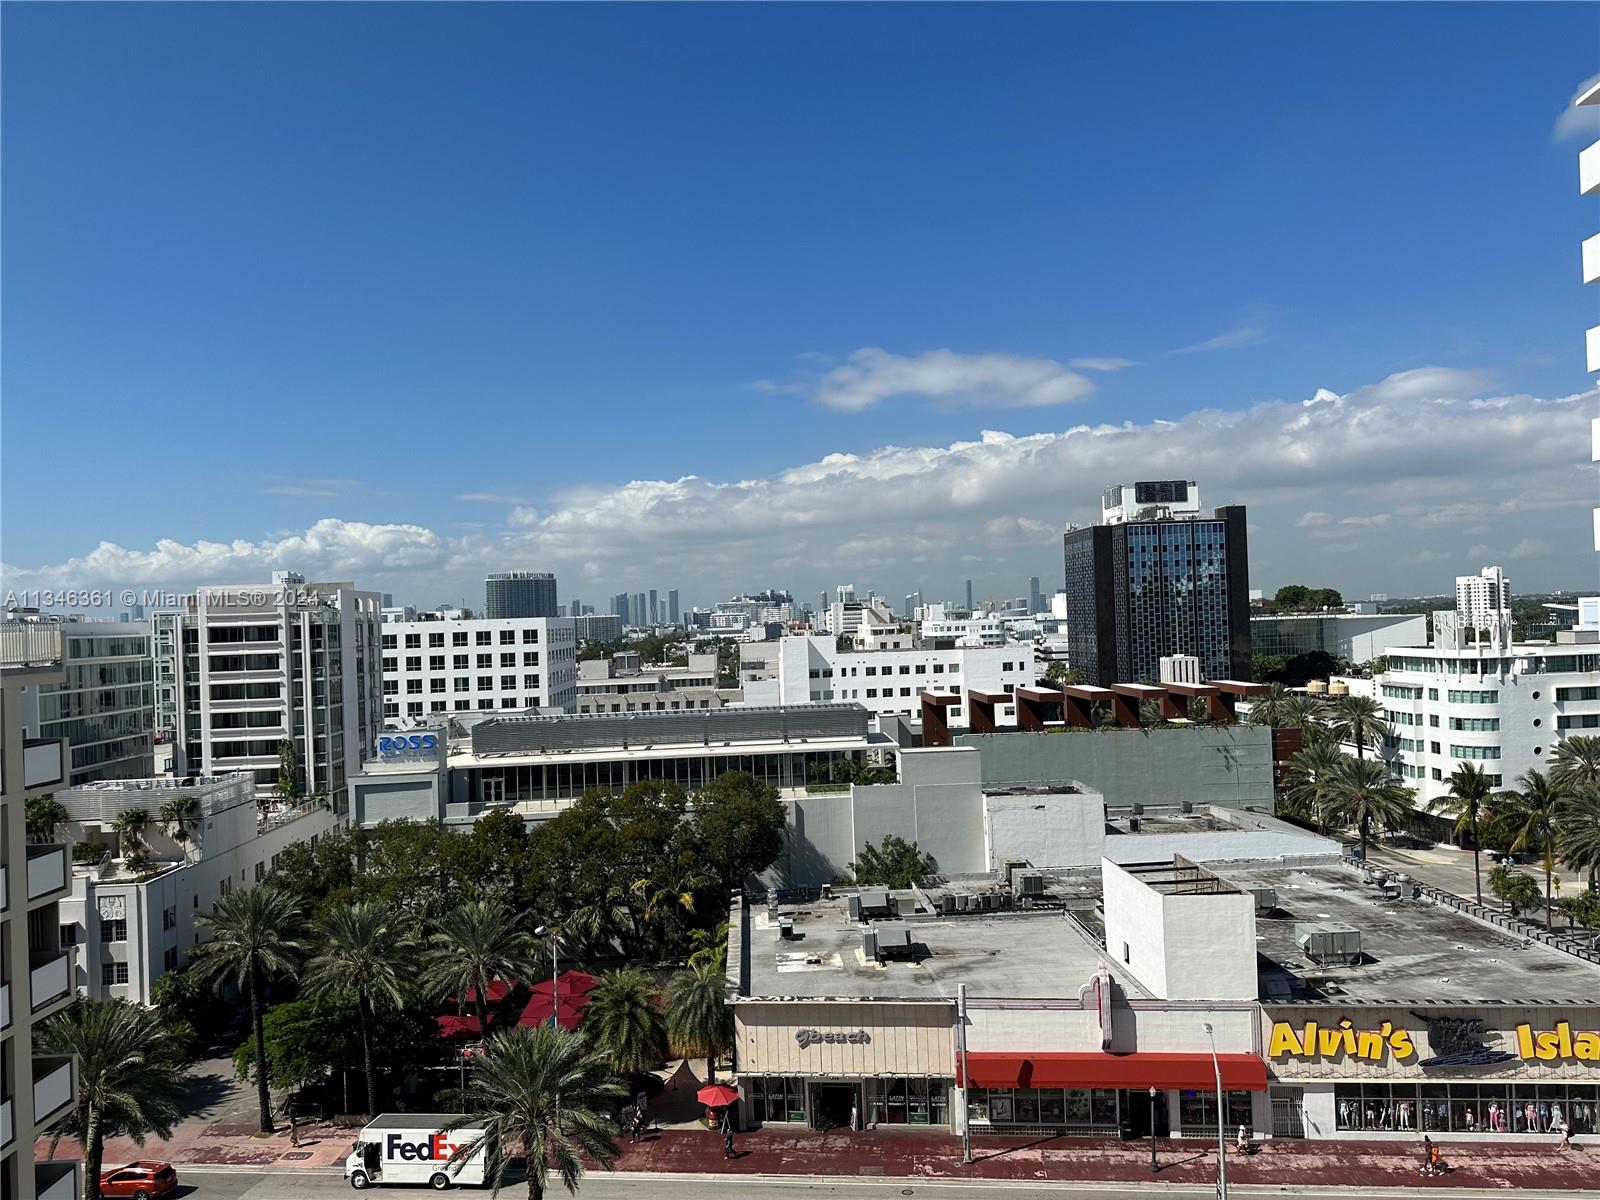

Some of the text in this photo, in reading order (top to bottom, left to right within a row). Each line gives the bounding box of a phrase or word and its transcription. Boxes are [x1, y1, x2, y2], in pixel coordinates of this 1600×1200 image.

[379, 734, 437, 751] ROSS
[1268, 1018, 1414, 1060] Alvin's
[387, 1133, 466, 1161] FedEx
